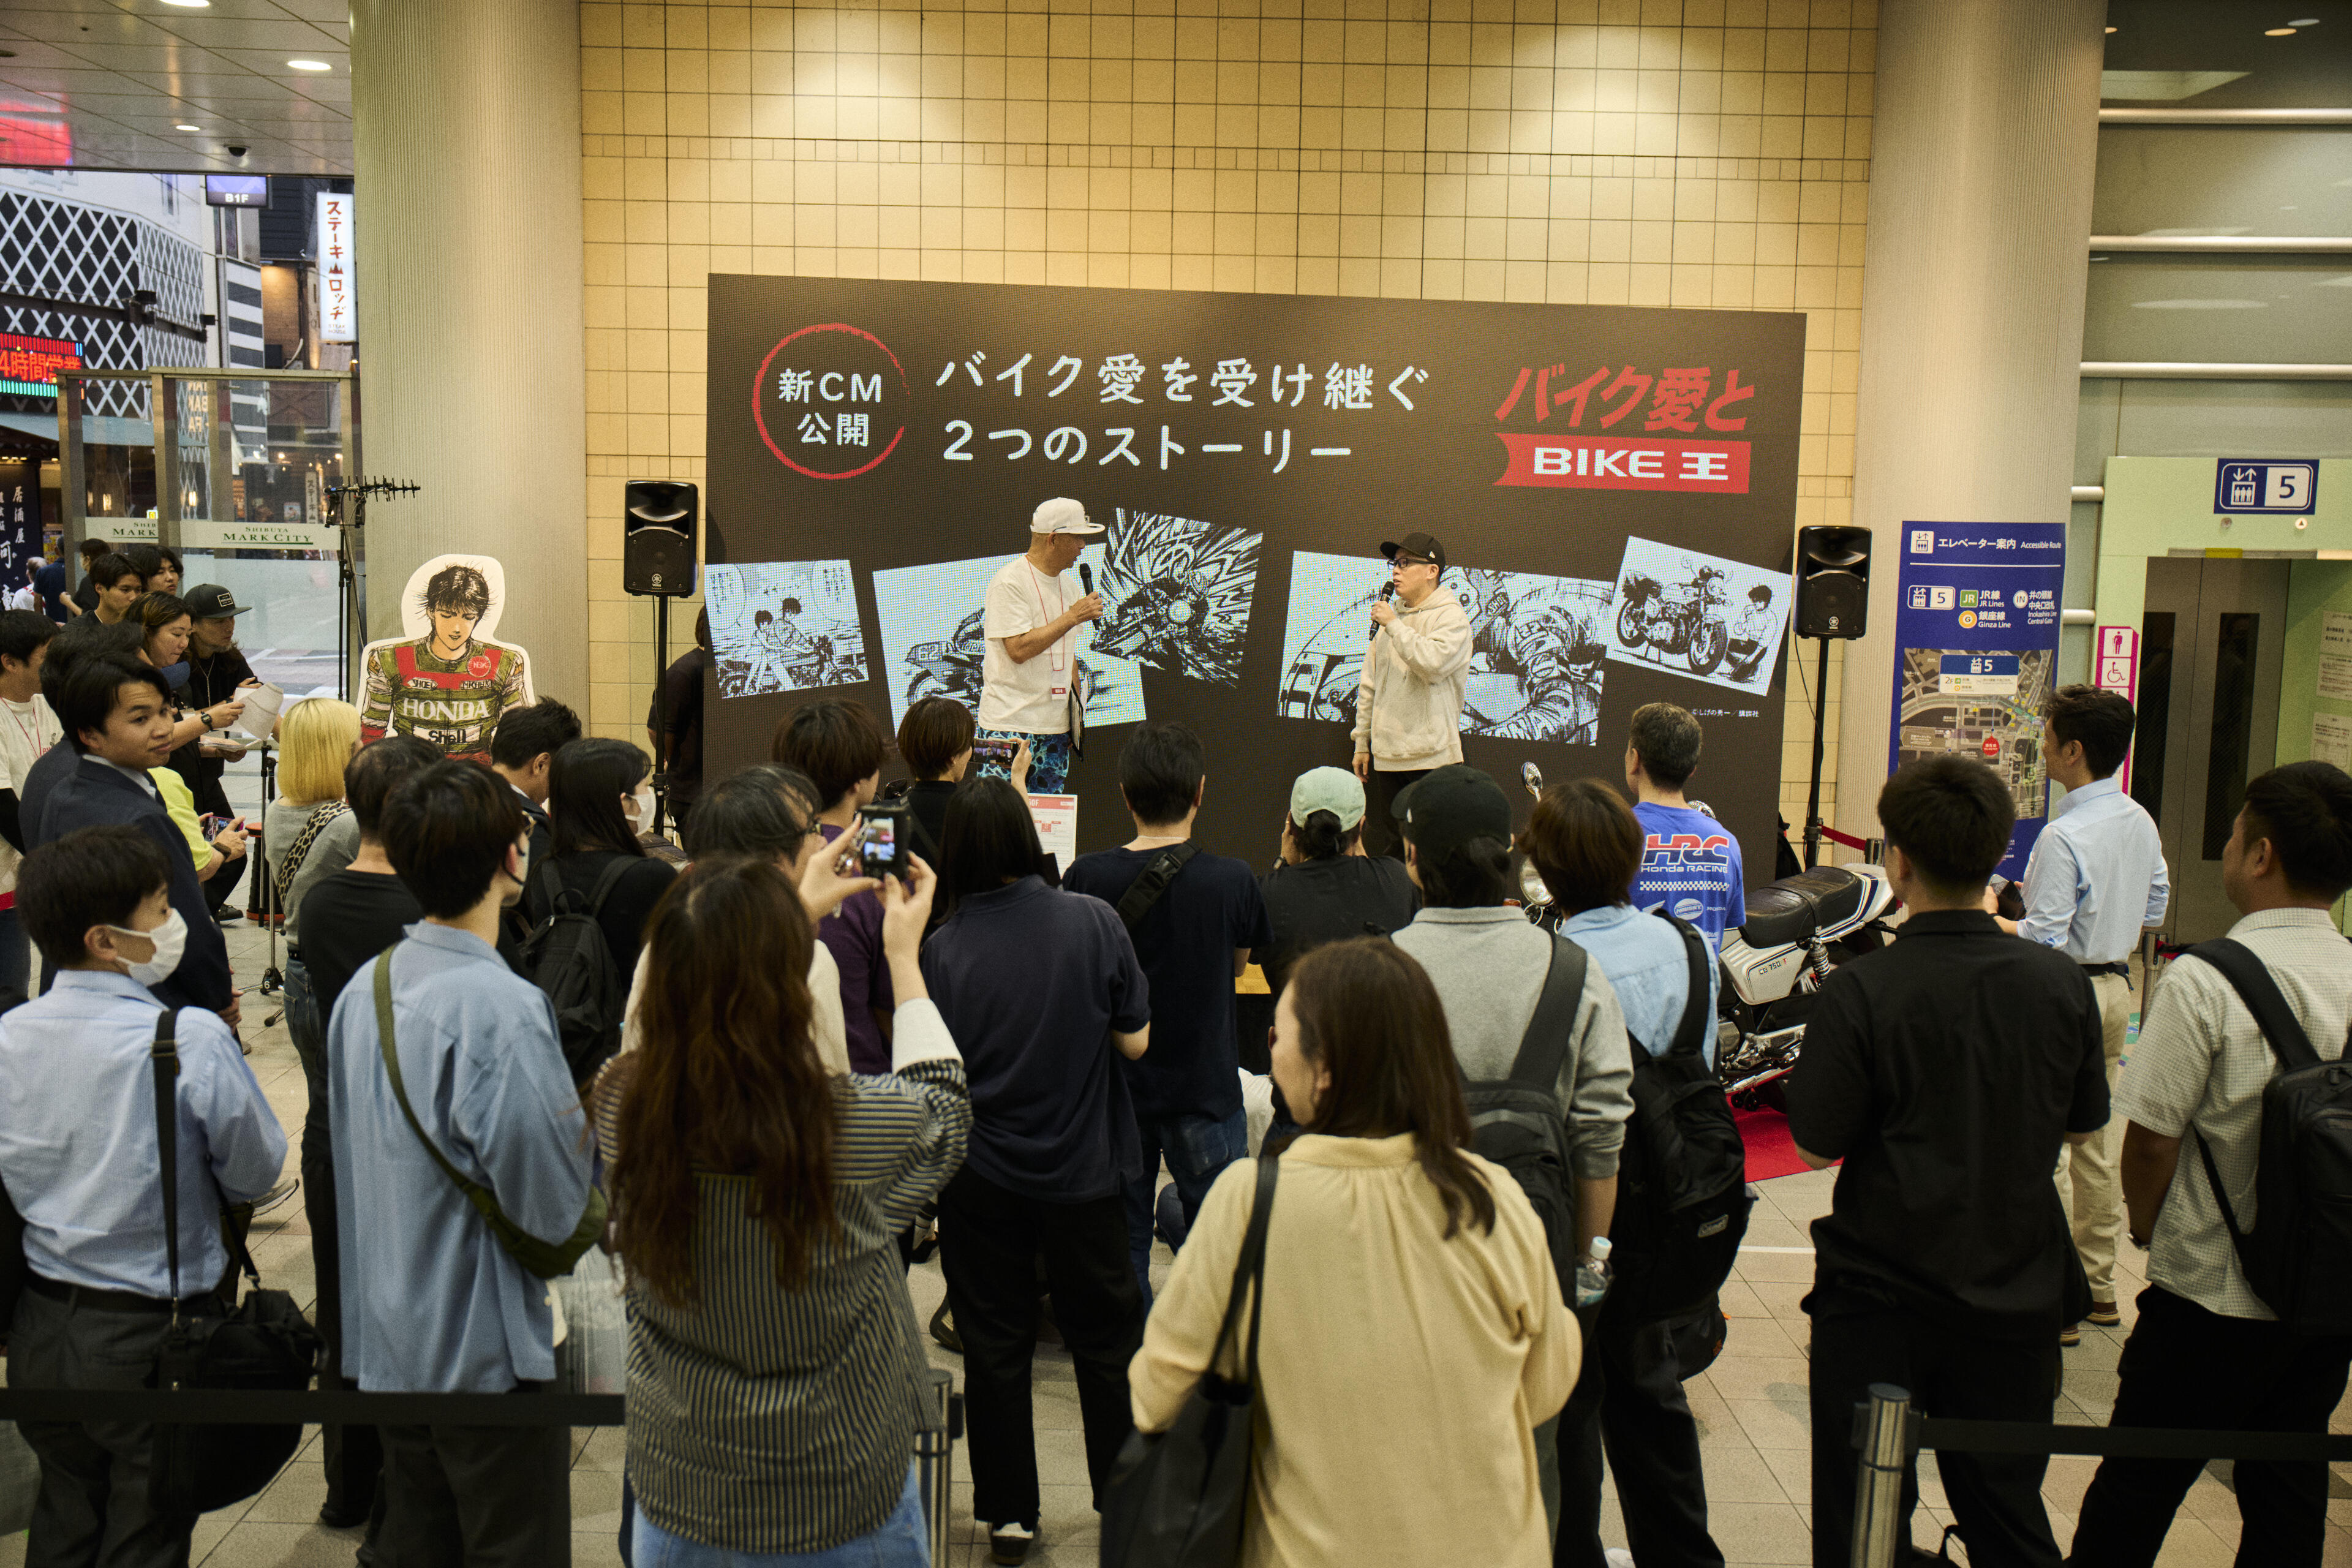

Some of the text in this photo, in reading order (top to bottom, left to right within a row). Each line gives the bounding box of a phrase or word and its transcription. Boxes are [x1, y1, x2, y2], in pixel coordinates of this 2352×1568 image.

[225, 193, 249, 203] B1F
[778, 368, 882, 403] 新CM
[936, 350, 1429, 410] バイク愛を受け継ぐ
[1494, 363, 1754, 432] バイク愛と
[797, 412, 869, 447] 公開
[943, 420, 1352, 473] 2つのストーリー
[1534, 447, 1728, 480] BIKE 王
[2279, 475, 2296, 499] 5
[12, 486, 25, 543] 居酒屋
[274, 533, 313, 542] CITY
[1938, 538, 2016, 549] エレベーター案内
[1937, 592, 1946, 604] 5
[1963, 594, 1975, 603] JR
[1980, 590, 2000, 600] JR線
[1978, 611, 2005, 620] 銀座線
[1984, 659, 1993, 673] 5
[402, 698, 491, 721] HONDA
[428, 729, 467, 745] Shell
[1641, 834, 1729, 867] HRC
[1686, 865, 1728, 873] RACING
[1769, 961, 1781, 970] 750
[264, 981, 270, 989] 6
